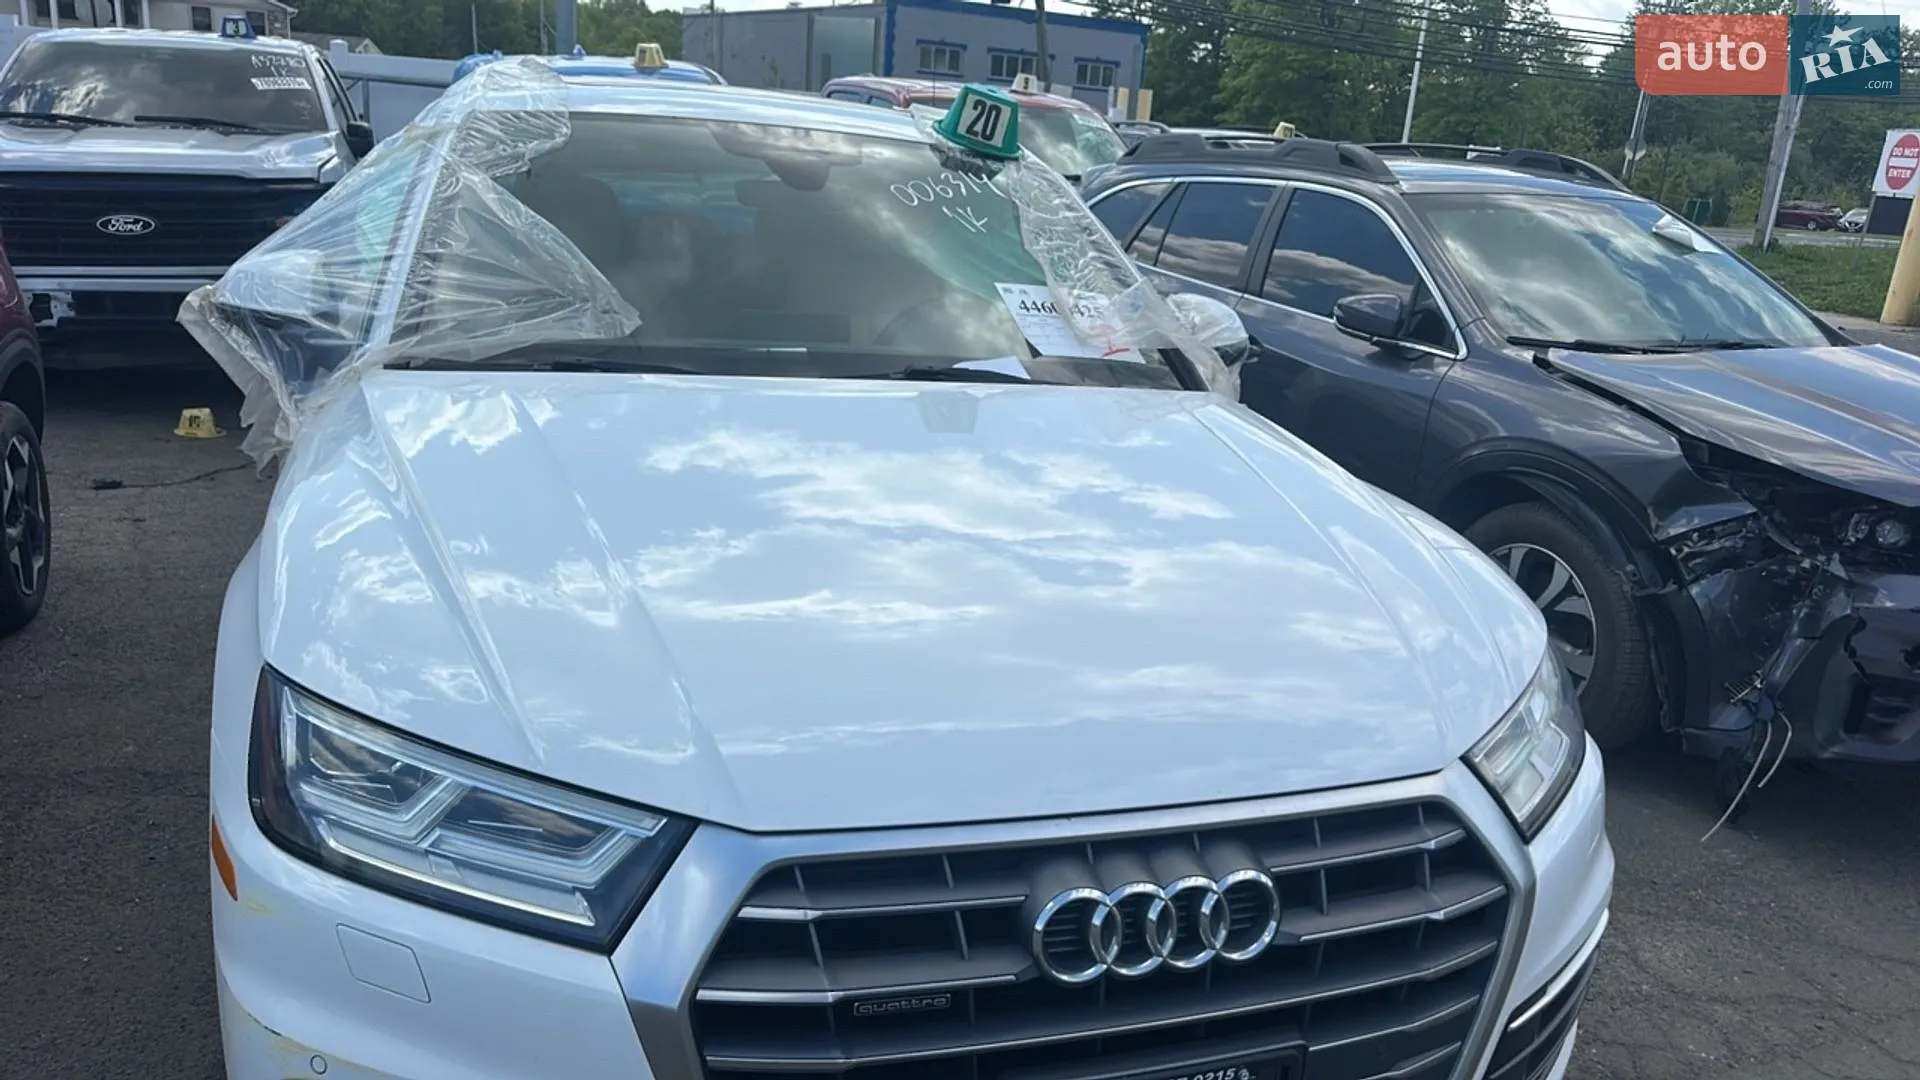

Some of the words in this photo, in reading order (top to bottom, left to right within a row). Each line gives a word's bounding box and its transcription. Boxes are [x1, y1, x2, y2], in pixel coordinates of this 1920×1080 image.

[966, 98, 1002, 142] 20
[1892, 146, 1904, 156] DO
[1888, 168, 1911, 178] ENTER
[890, 170, 1009, 206] 006314
[108, 218, 143, 231] Ford
[1018, 299, 1106, 321] 446425
[859, 998, 947, 1016] quattro
